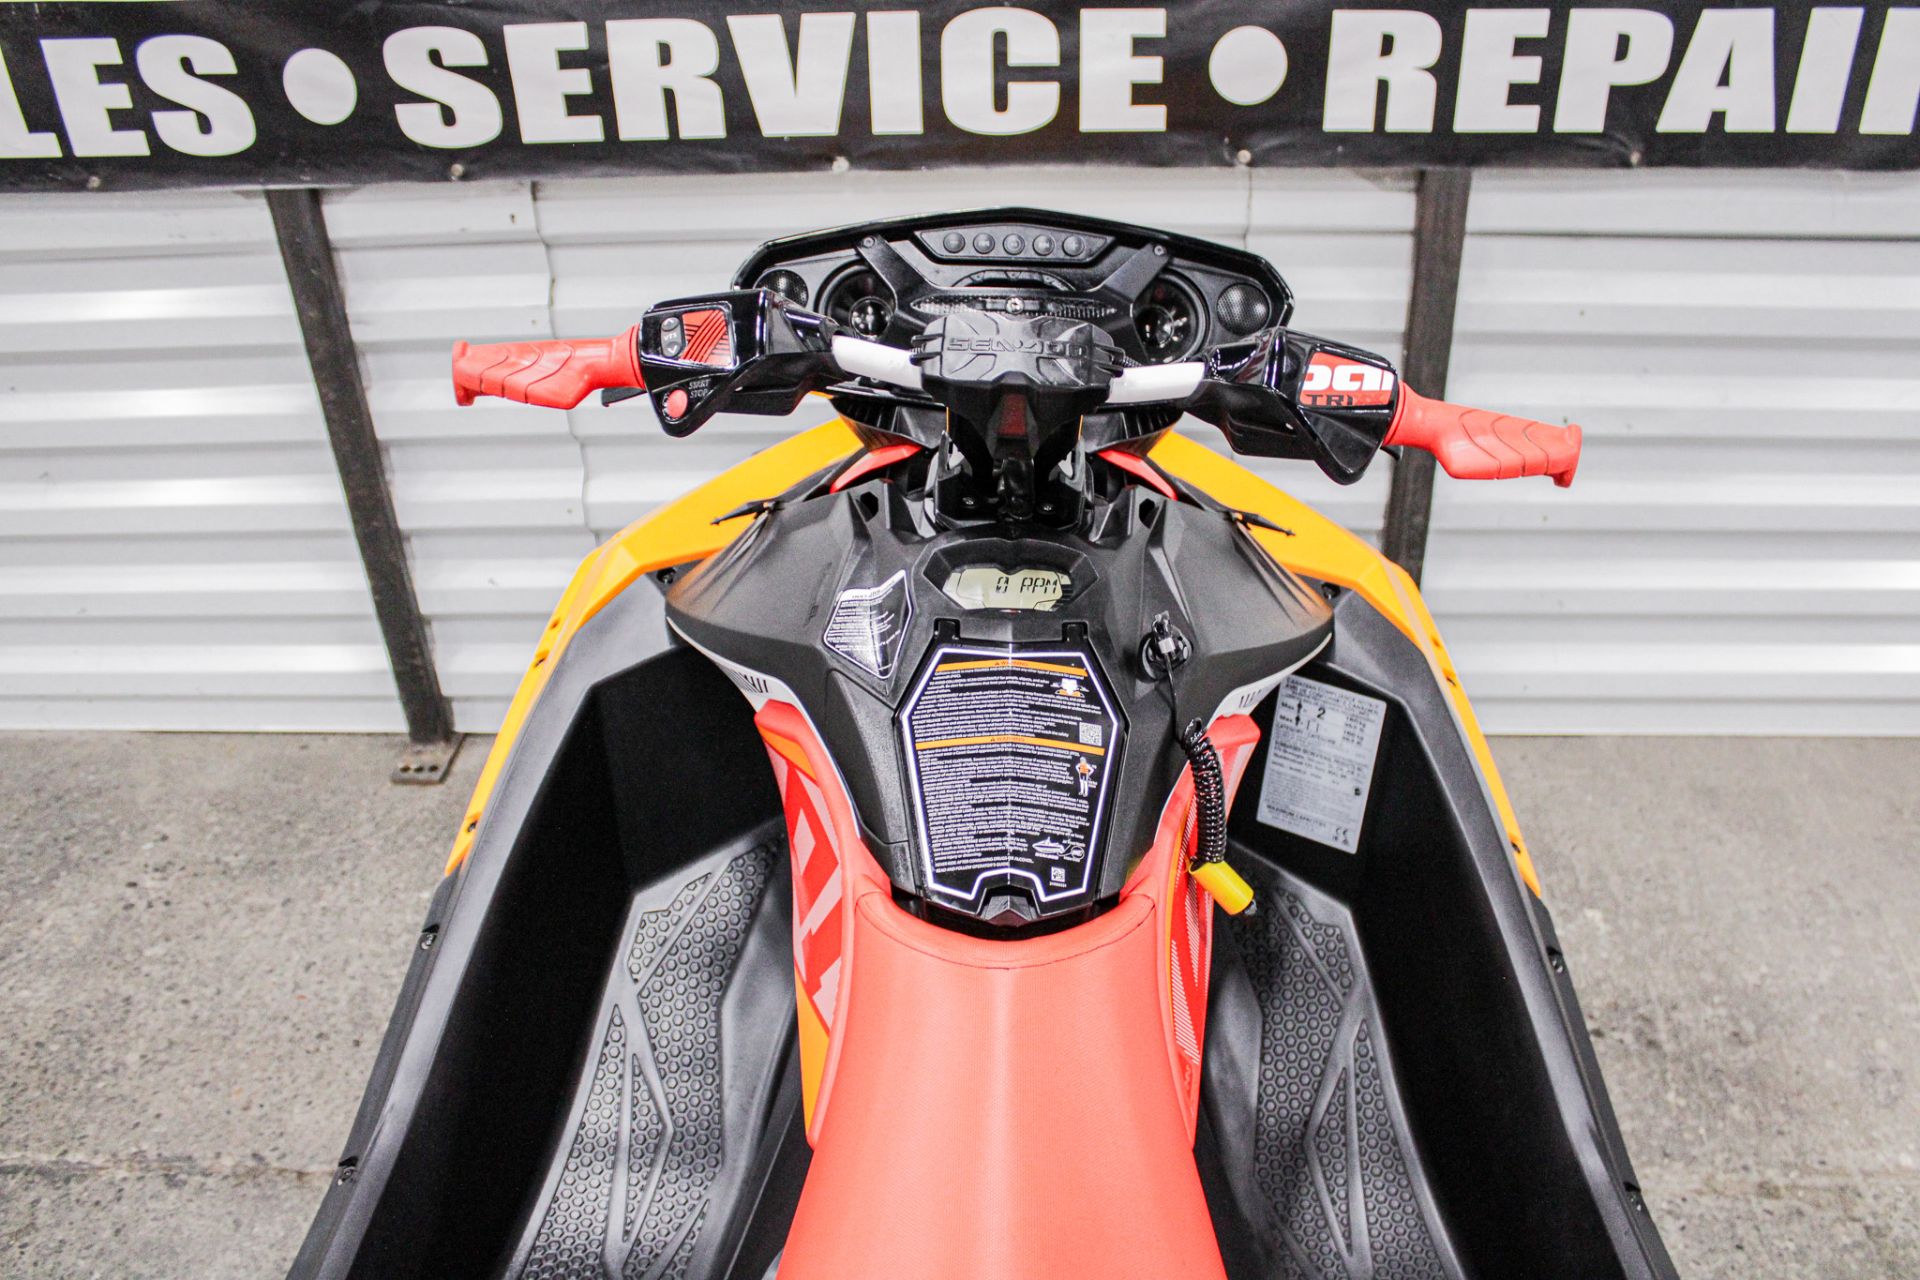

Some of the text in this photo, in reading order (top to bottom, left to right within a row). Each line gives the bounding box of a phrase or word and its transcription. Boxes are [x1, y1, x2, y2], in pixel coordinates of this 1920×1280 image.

[383, 7, 1167, 149] SERVICE
[689, 379, 711, 389] START
[690, 389, 708, 398] STOP
[1316, 707, 1327, 720] 2
